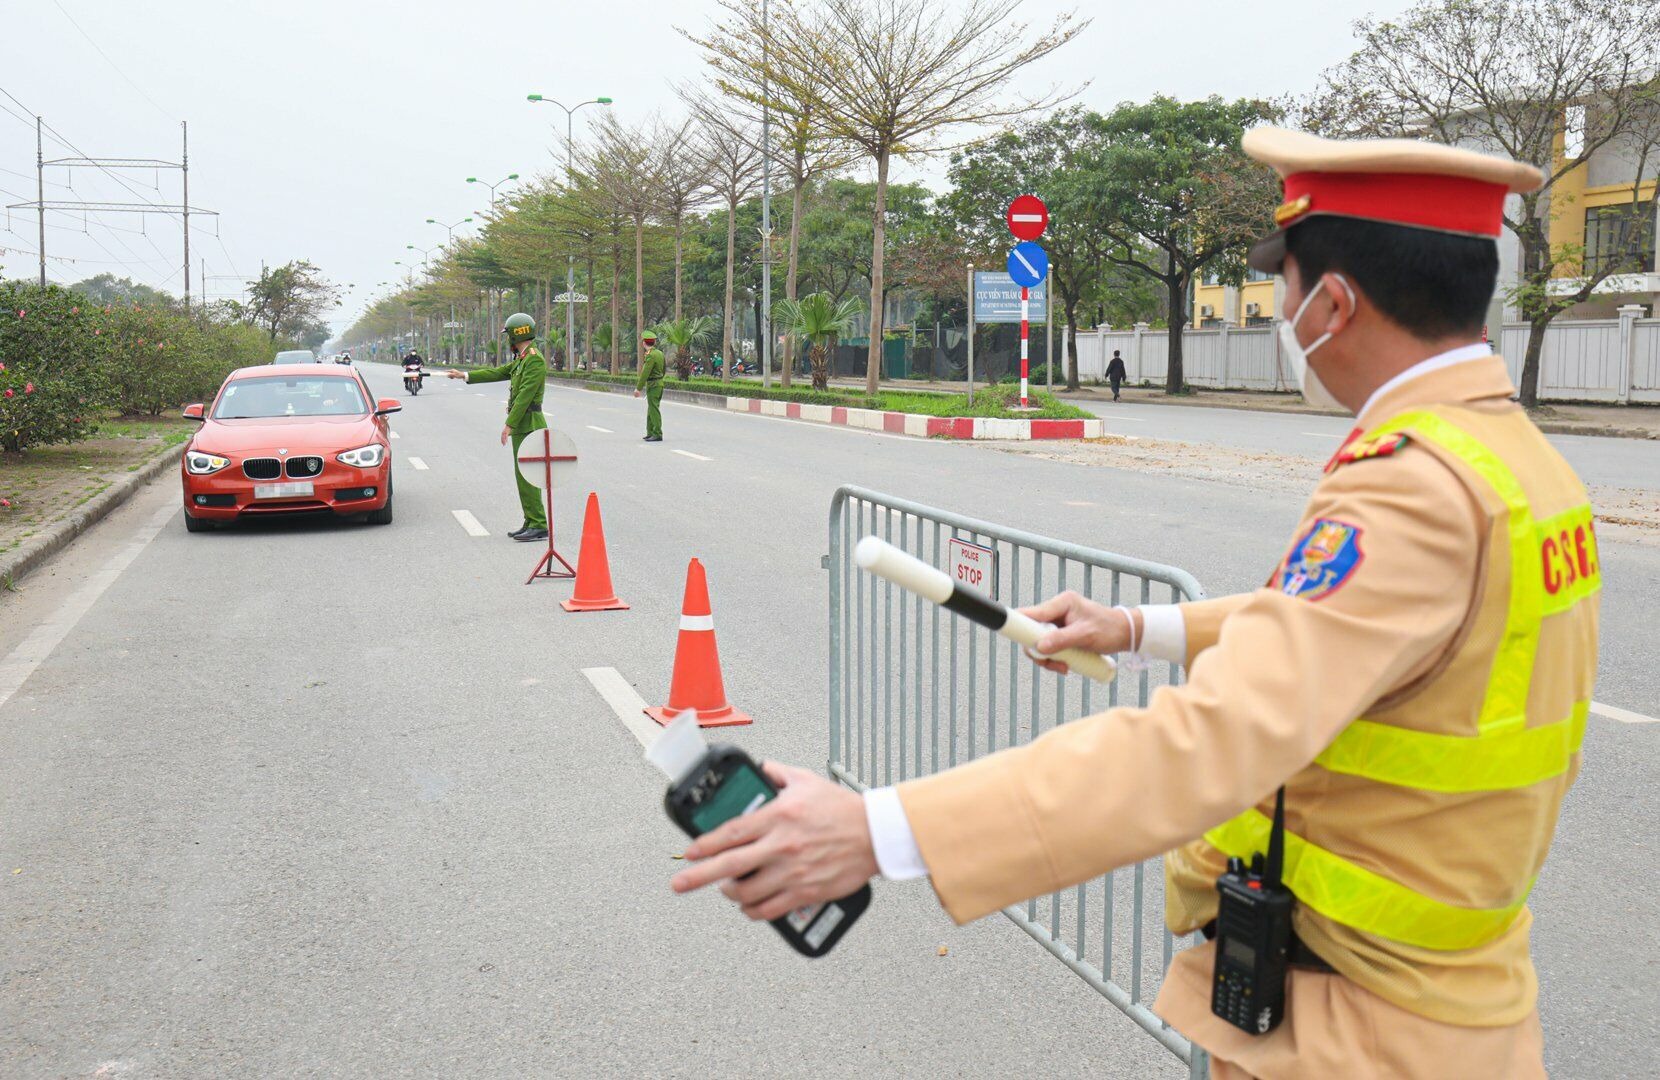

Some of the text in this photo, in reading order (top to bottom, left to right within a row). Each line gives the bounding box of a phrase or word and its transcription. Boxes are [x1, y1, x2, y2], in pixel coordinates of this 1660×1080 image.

[514, 326, 530, 335] CSTT
[961, 548, 979, 561] POLICE
[958, 563, 982, 586] STOP
